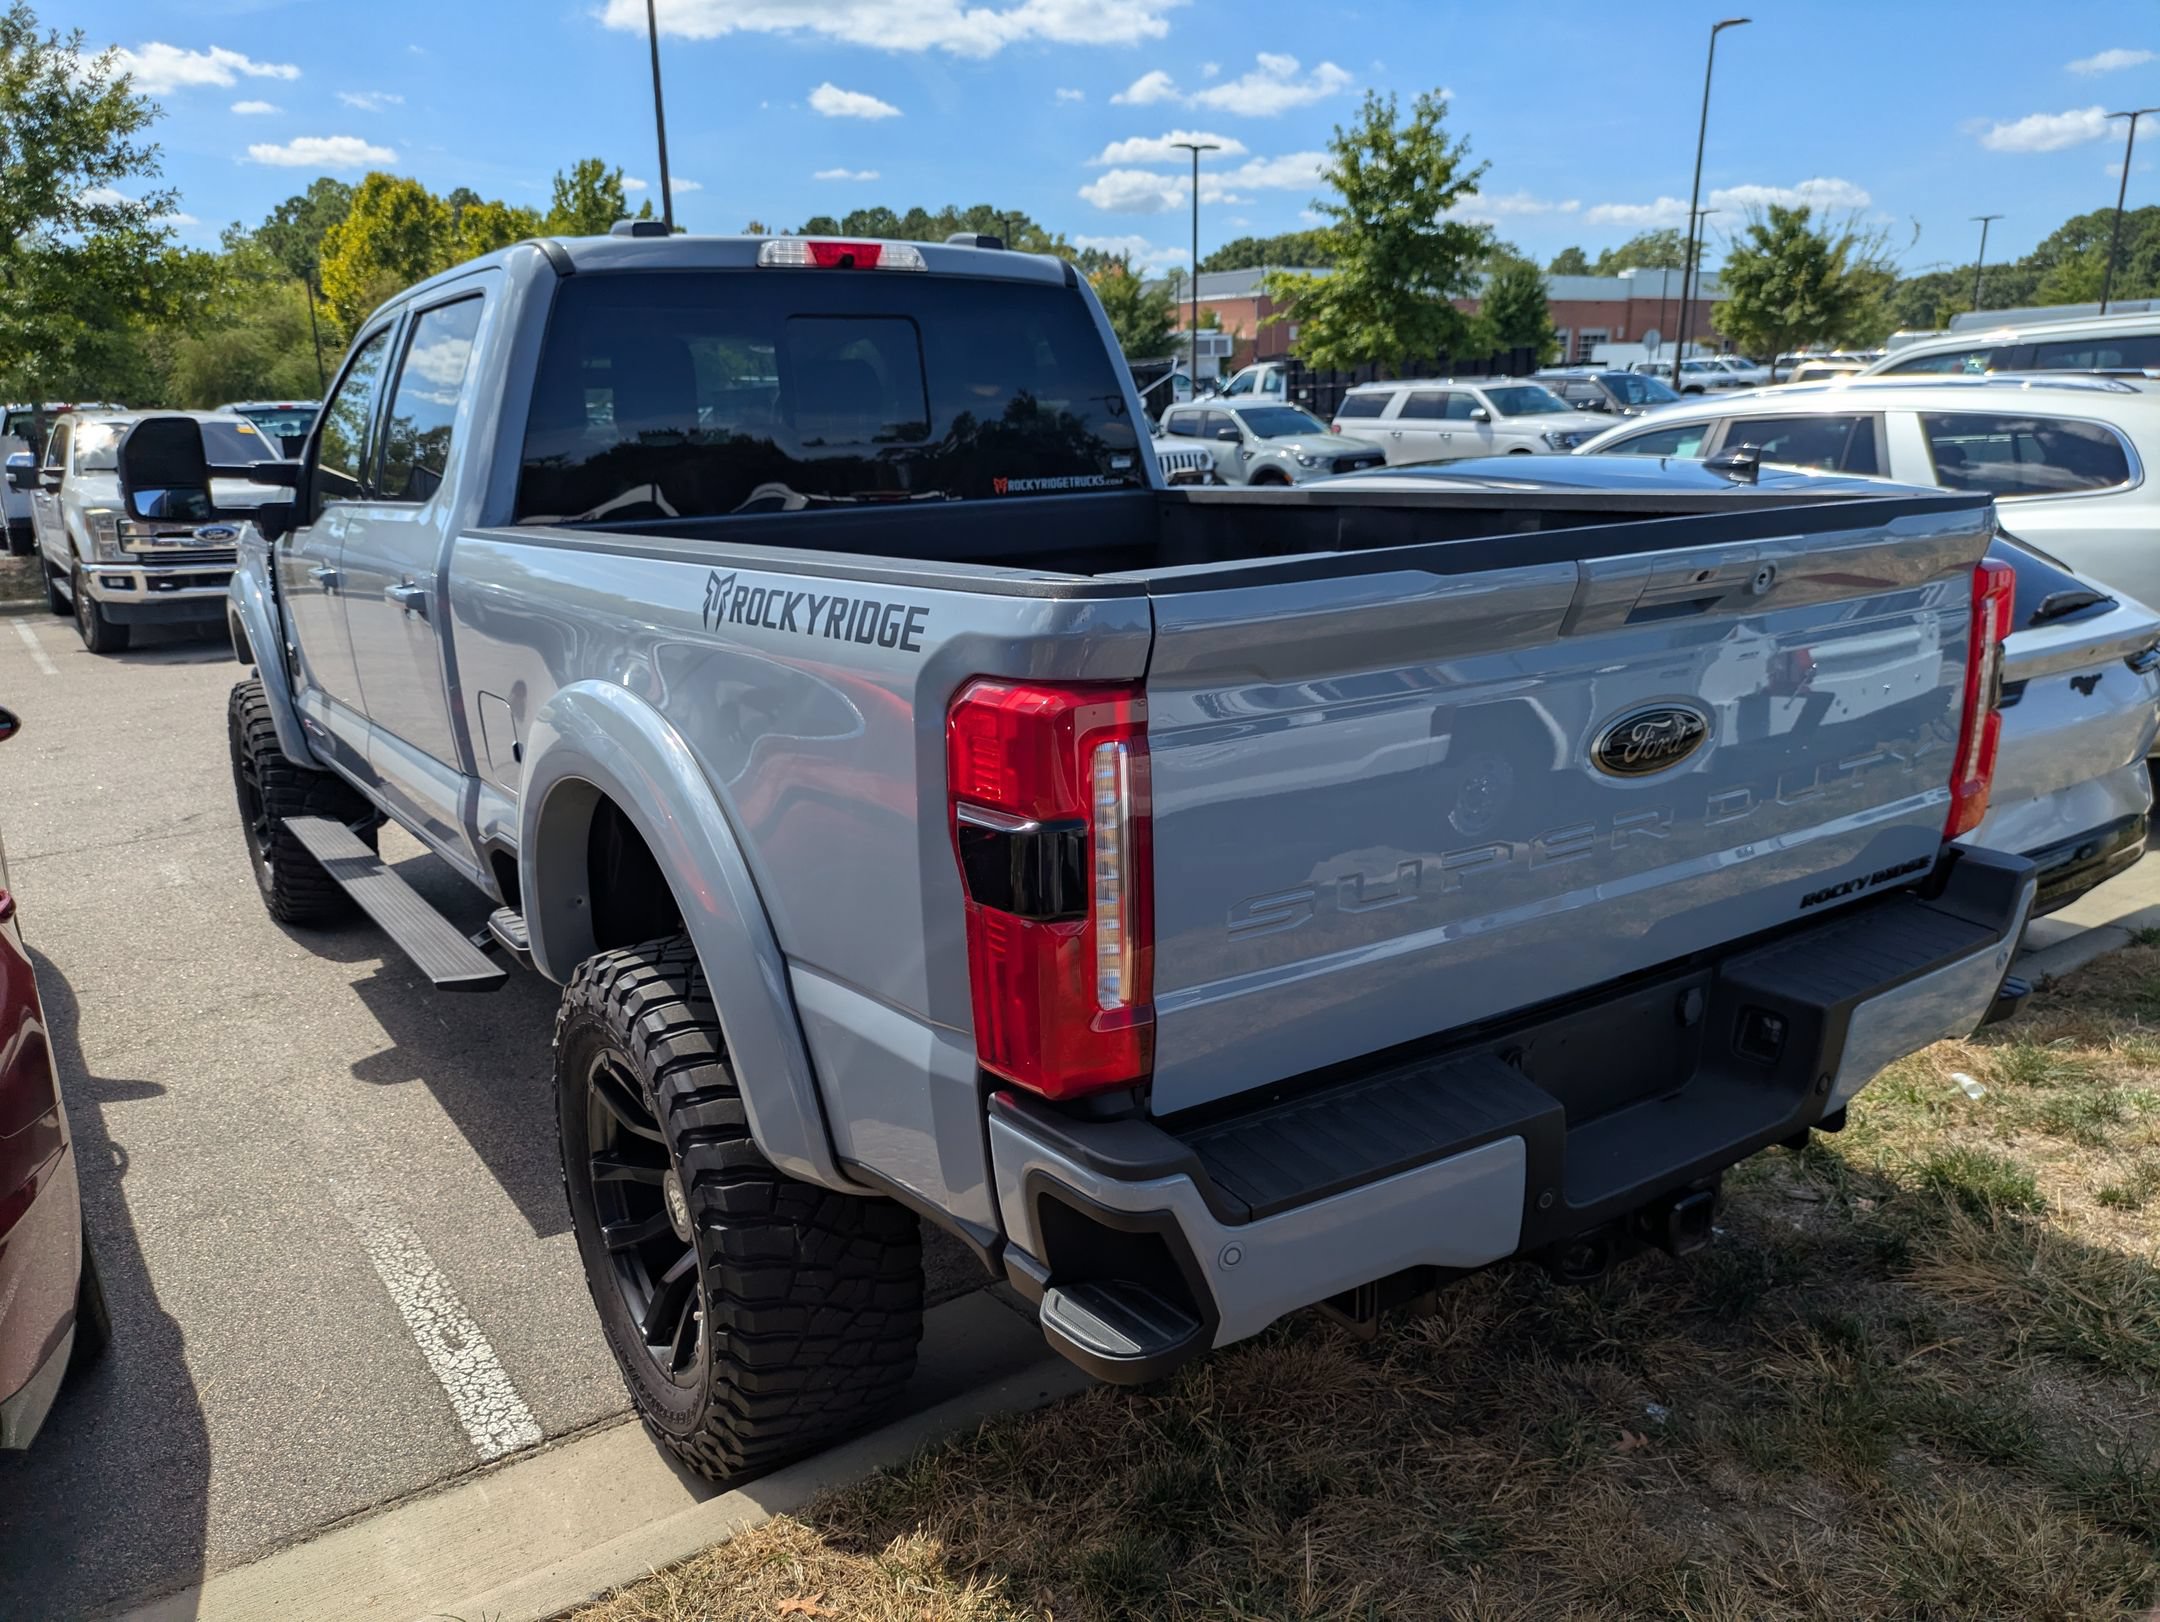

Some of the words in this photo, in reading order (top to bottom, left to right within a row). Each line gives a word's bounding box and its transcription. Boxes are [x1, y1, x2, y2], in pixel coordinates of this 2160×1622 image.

[728, 585, 930, 653] ROCKYRIDGE
[1624, 713, 1687, 763] Ford
[1227, 806, 1675, 942] SUPER
[1703, 738, 1936, 828] DUTY
